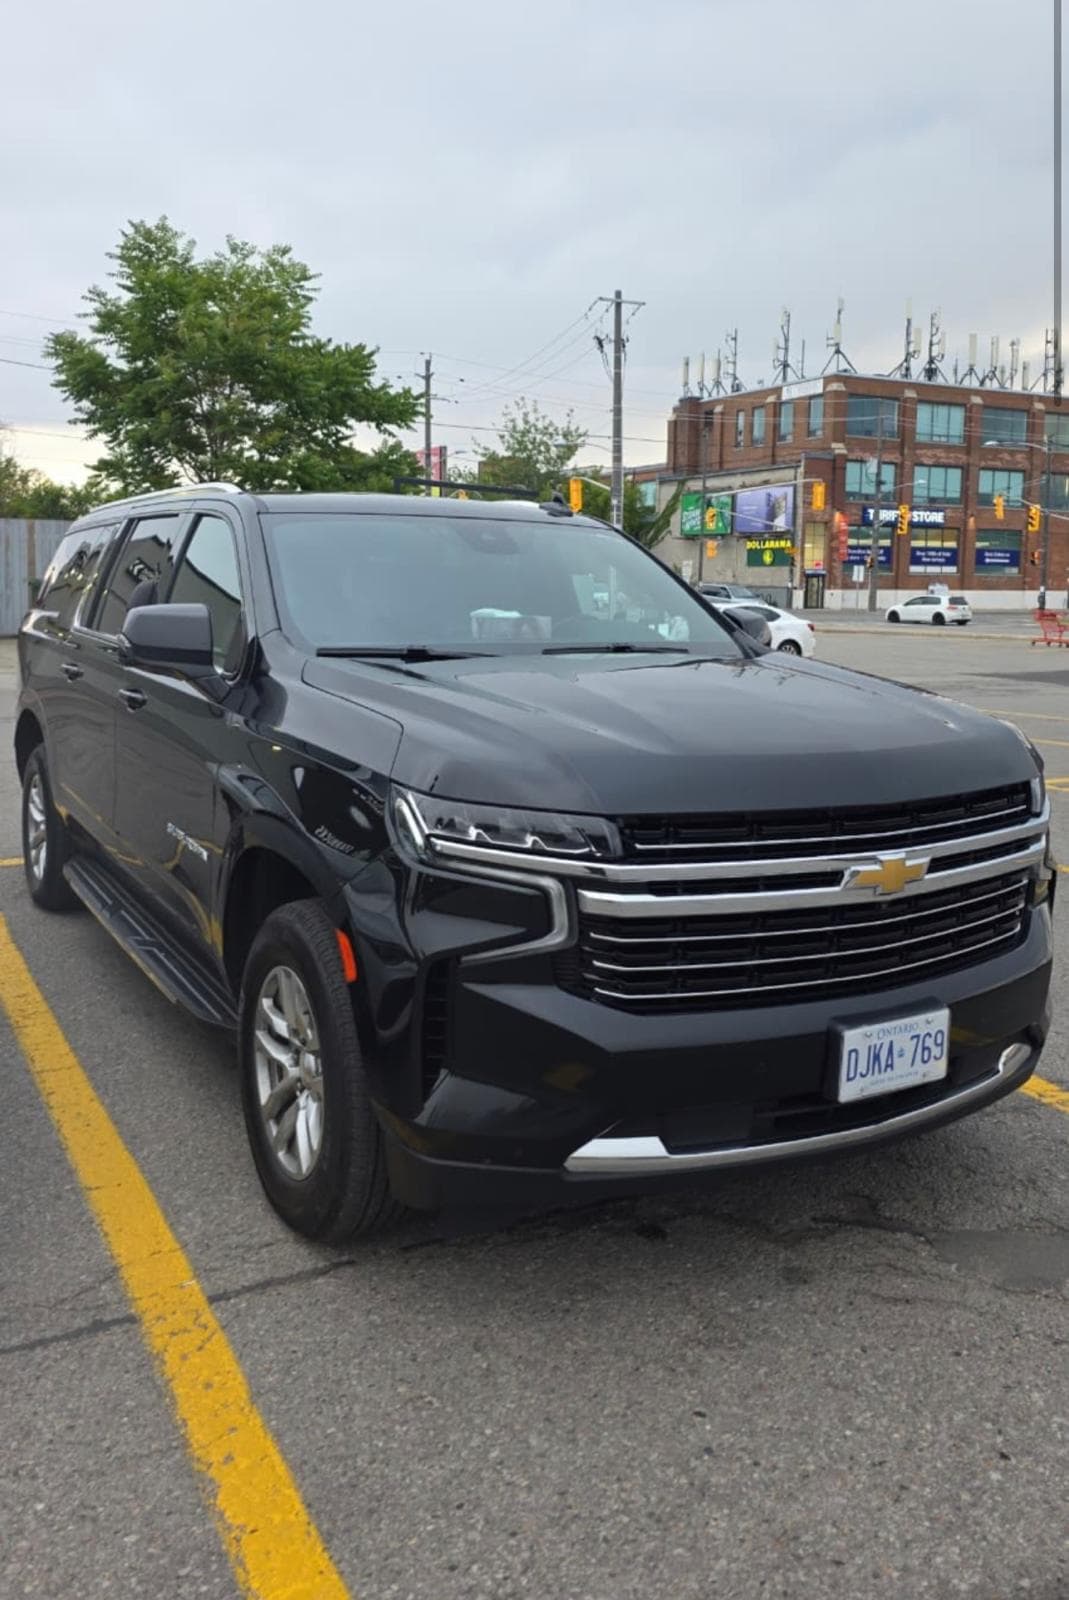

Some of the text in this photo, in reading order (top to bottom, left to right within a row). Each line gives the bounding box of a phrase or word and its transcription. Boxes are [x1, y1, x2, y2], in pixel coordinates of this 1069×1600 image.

[867, 508, 945, 523] TRIF STORE
[746, 539, 792, 550] DOLLARAMA
[877, 1022, 919, 1040] ONTARIO
[846, 1029, 945, 1083] DJKA 769
